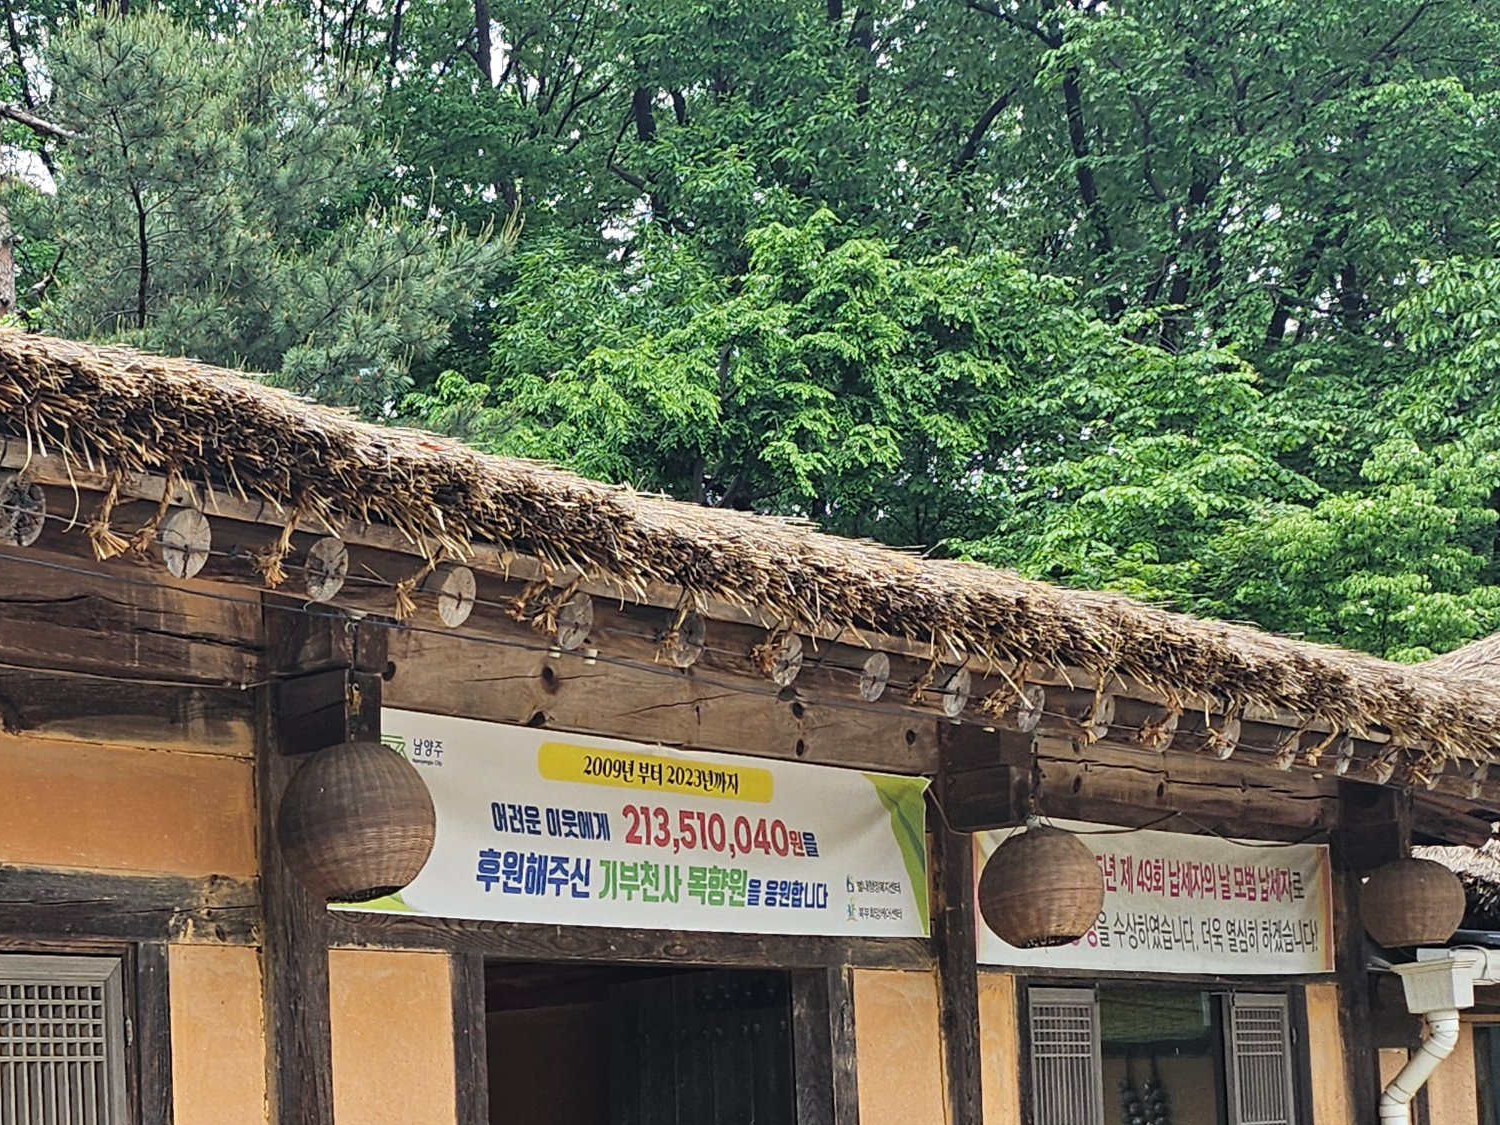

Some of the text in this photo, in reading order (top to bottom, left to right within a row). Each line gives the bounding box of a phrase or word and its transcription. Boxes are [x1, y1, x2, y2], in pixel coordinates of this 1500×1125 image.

[413, 738, 444, 758] 남양주
[583, 755, 739, 795] 2009년 부터 2023년까지
[491, 802, 819, 859] 어려운 이웃에게 213,510,040원을
[476, 848, 829, 909] 후원해주신 기부천사 목향원을 응원합니다
[1095, 853, 1305, 903] 년 제 49회 납세자의 날 모범 납세자로
[1201, 917, 1223, 953] 더욱
[1226, 918, 1259, 953] 열심히
[1262, 919, 1318, 953] 하겠습니다!
